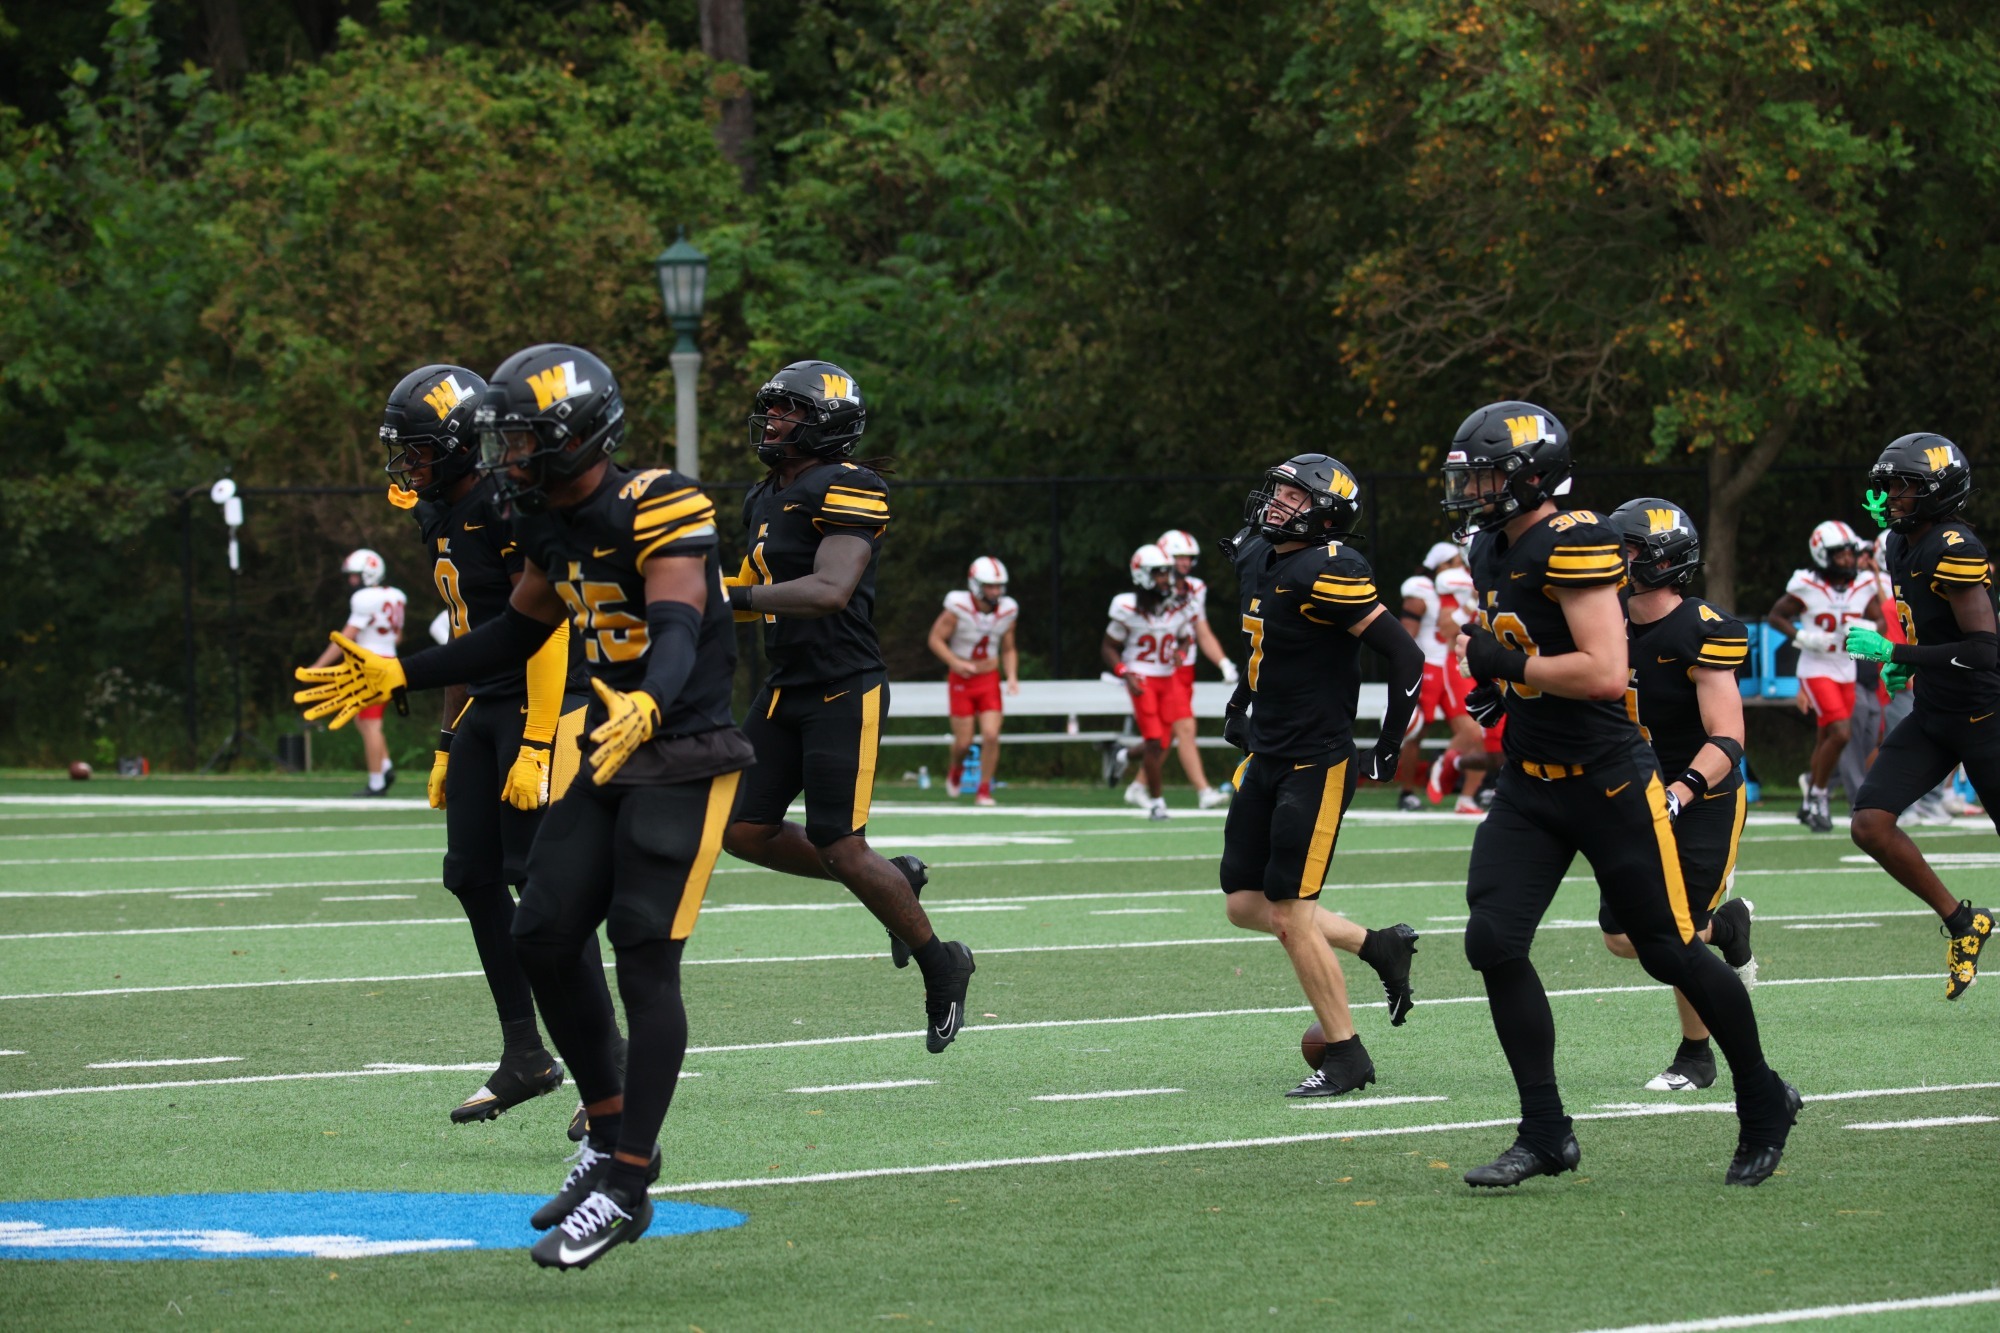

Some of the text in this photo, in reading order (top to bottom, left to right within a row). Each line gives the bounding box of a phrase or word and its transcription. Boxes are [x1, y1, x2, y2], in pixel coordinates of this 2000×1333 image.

[423, 374, 475, 421] WL
[526, 361, 592, 411] WL
[821, 373, 860, 406] WL
[1504, 415, 1557, 448] WL
[1924, 445, 1961, 472] WL
[1548, 510, 1599, 532] 30
[1645, 508, 1689, 536] WL
[437, 537, 452, 554] WL
[1942, 530, 1965, 546] 2
[434, 558, 471, 639] 0
[1698, 604, 1723, 621] 4
[972, 635, 990, 660] 4
[1242, 613, 1265, 693] 7
